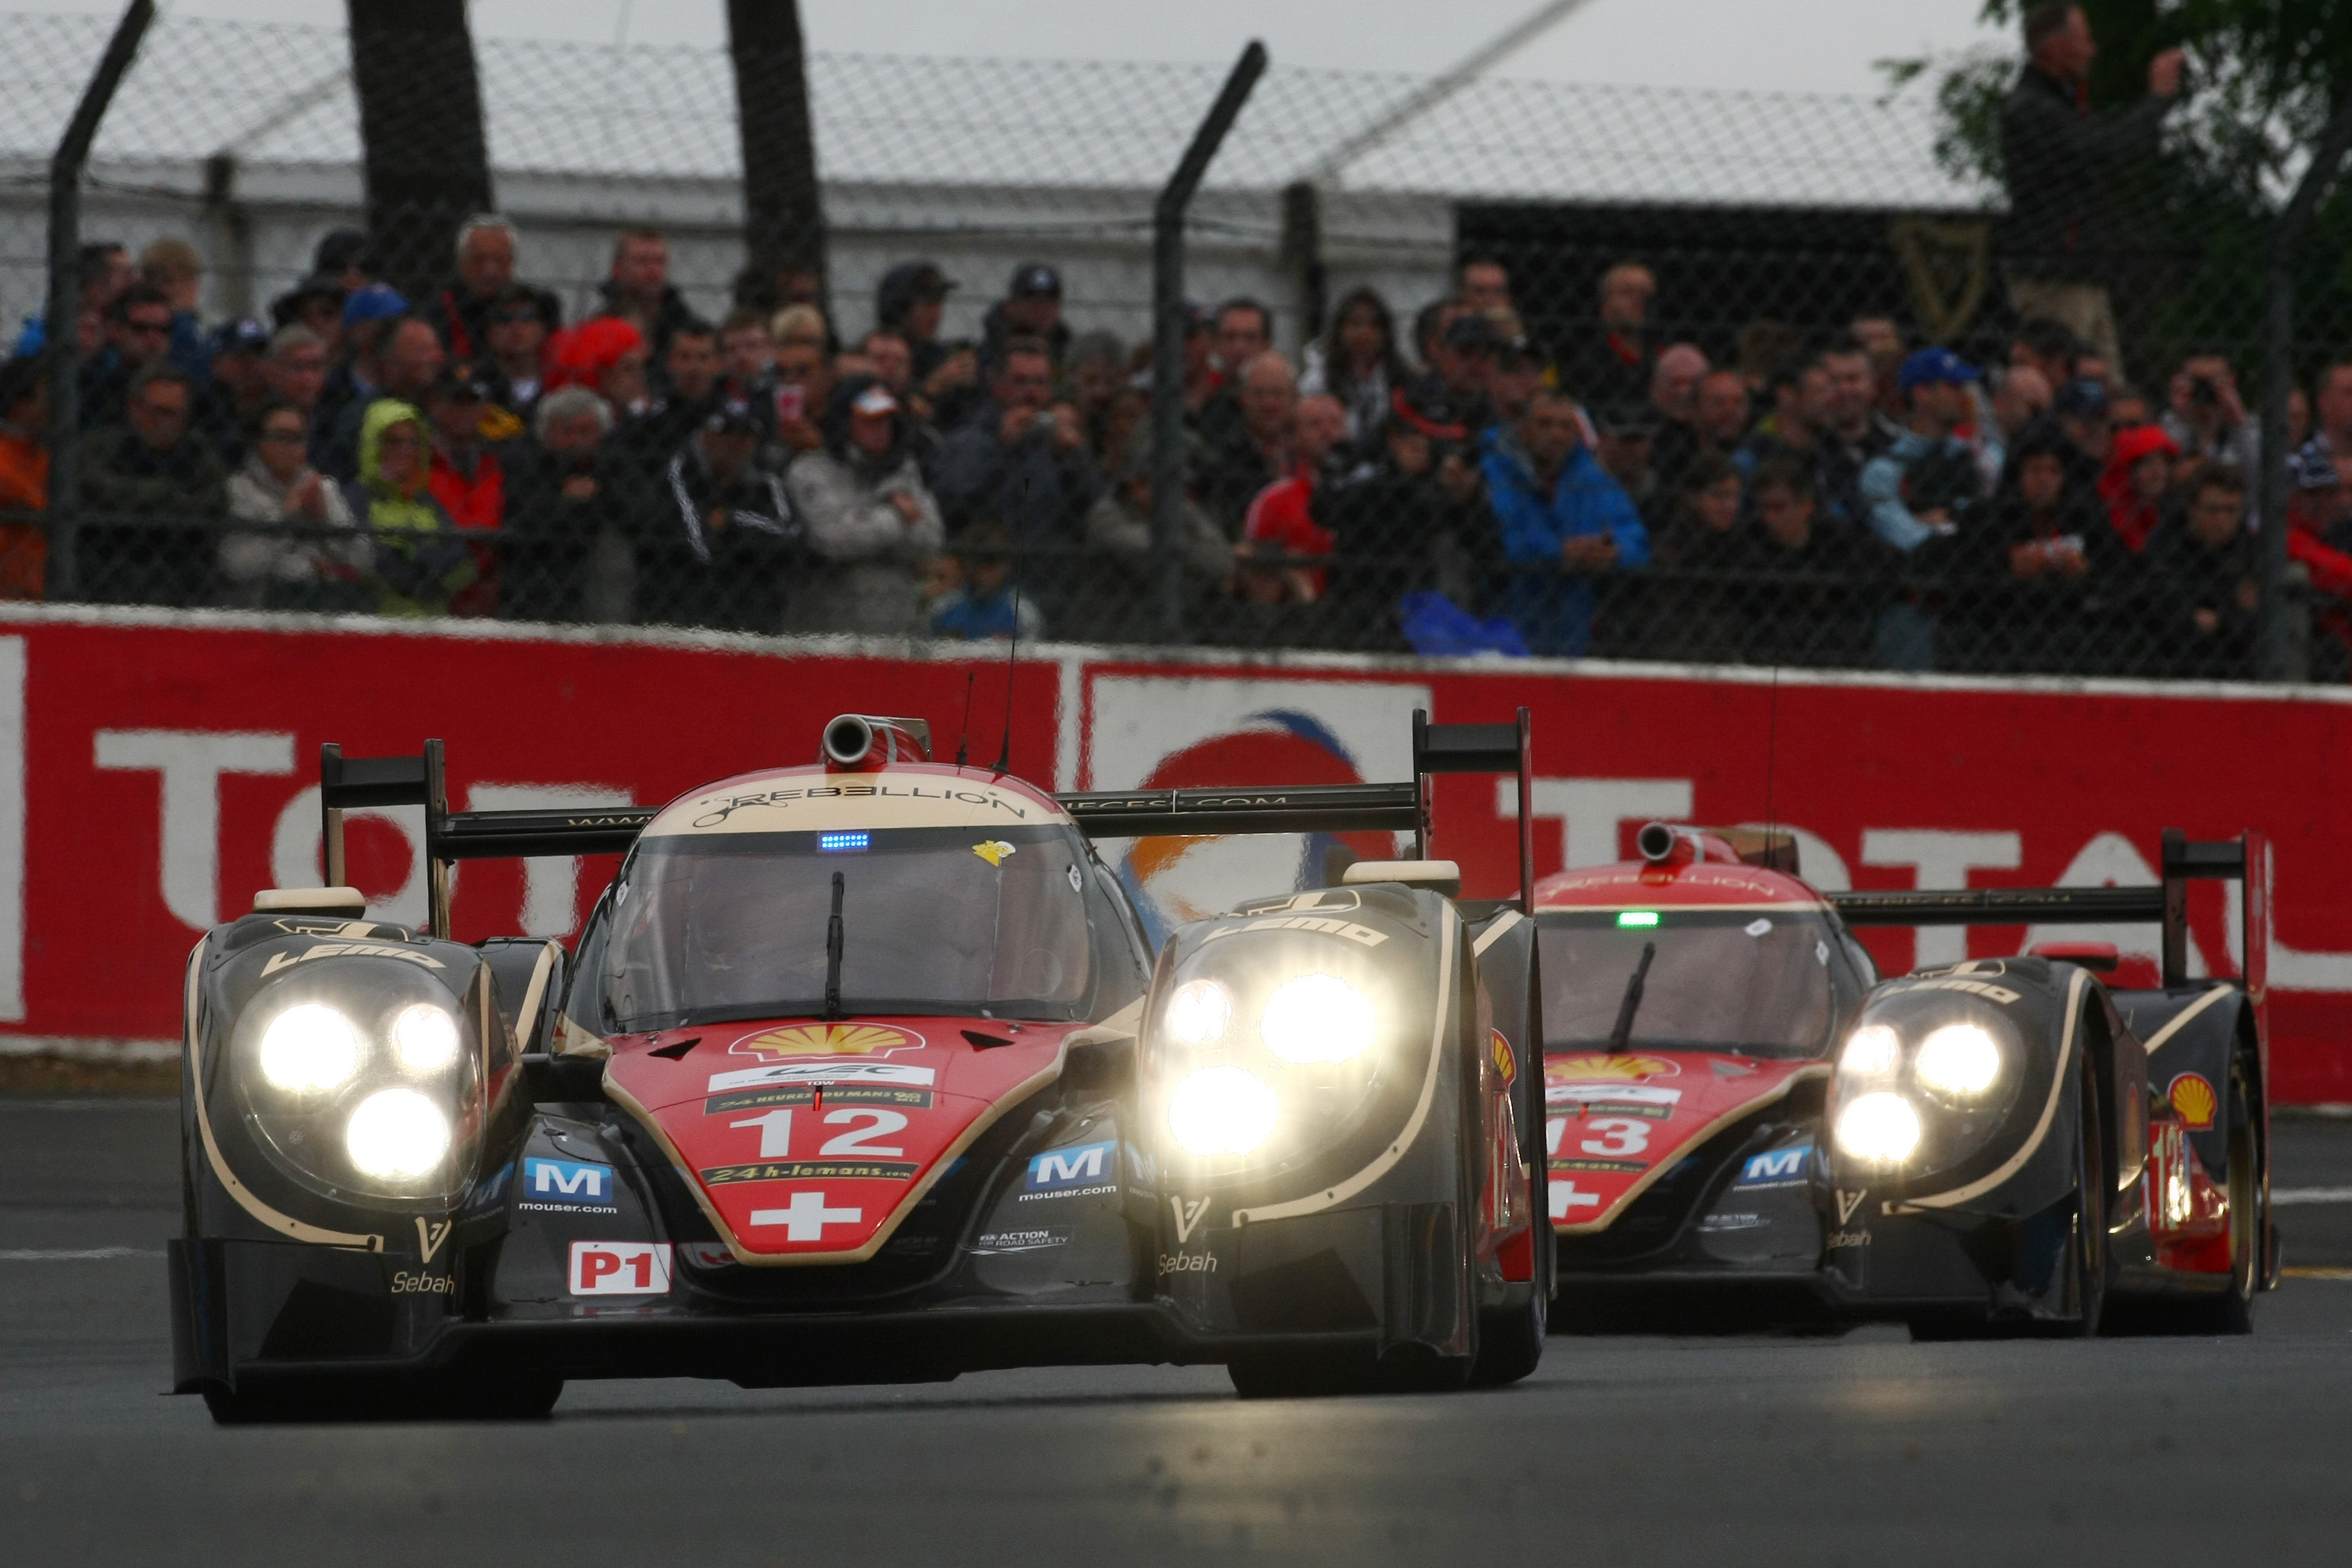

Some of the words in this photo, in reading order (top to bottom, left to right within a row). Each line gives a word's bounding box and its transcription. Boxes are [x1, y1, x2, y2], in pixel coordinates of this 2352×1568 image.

[693, 786, 1025, 828] REBELLION
[1201, 916, 1390, 947] LEMO
[260, 944, 447, 978] LEMO
[756, 1093, 814, 1103] HEURES
[729, 1108, 909, 1158] 12
[1546, 1118, 1651, 1156] 13
[713, 1166, 760, 1180] 24
[1019, 1185, 1117, 1202] mouser.com
[518, 1203, 618, 1214] mouser.com
[999, 1230, 1049, 1241] ACTION
[580, 1252, 652, 1289] P1
[1158, 1250, 1217, 1276] Sebah
[391, 1270, 455, 1295] Sebah
